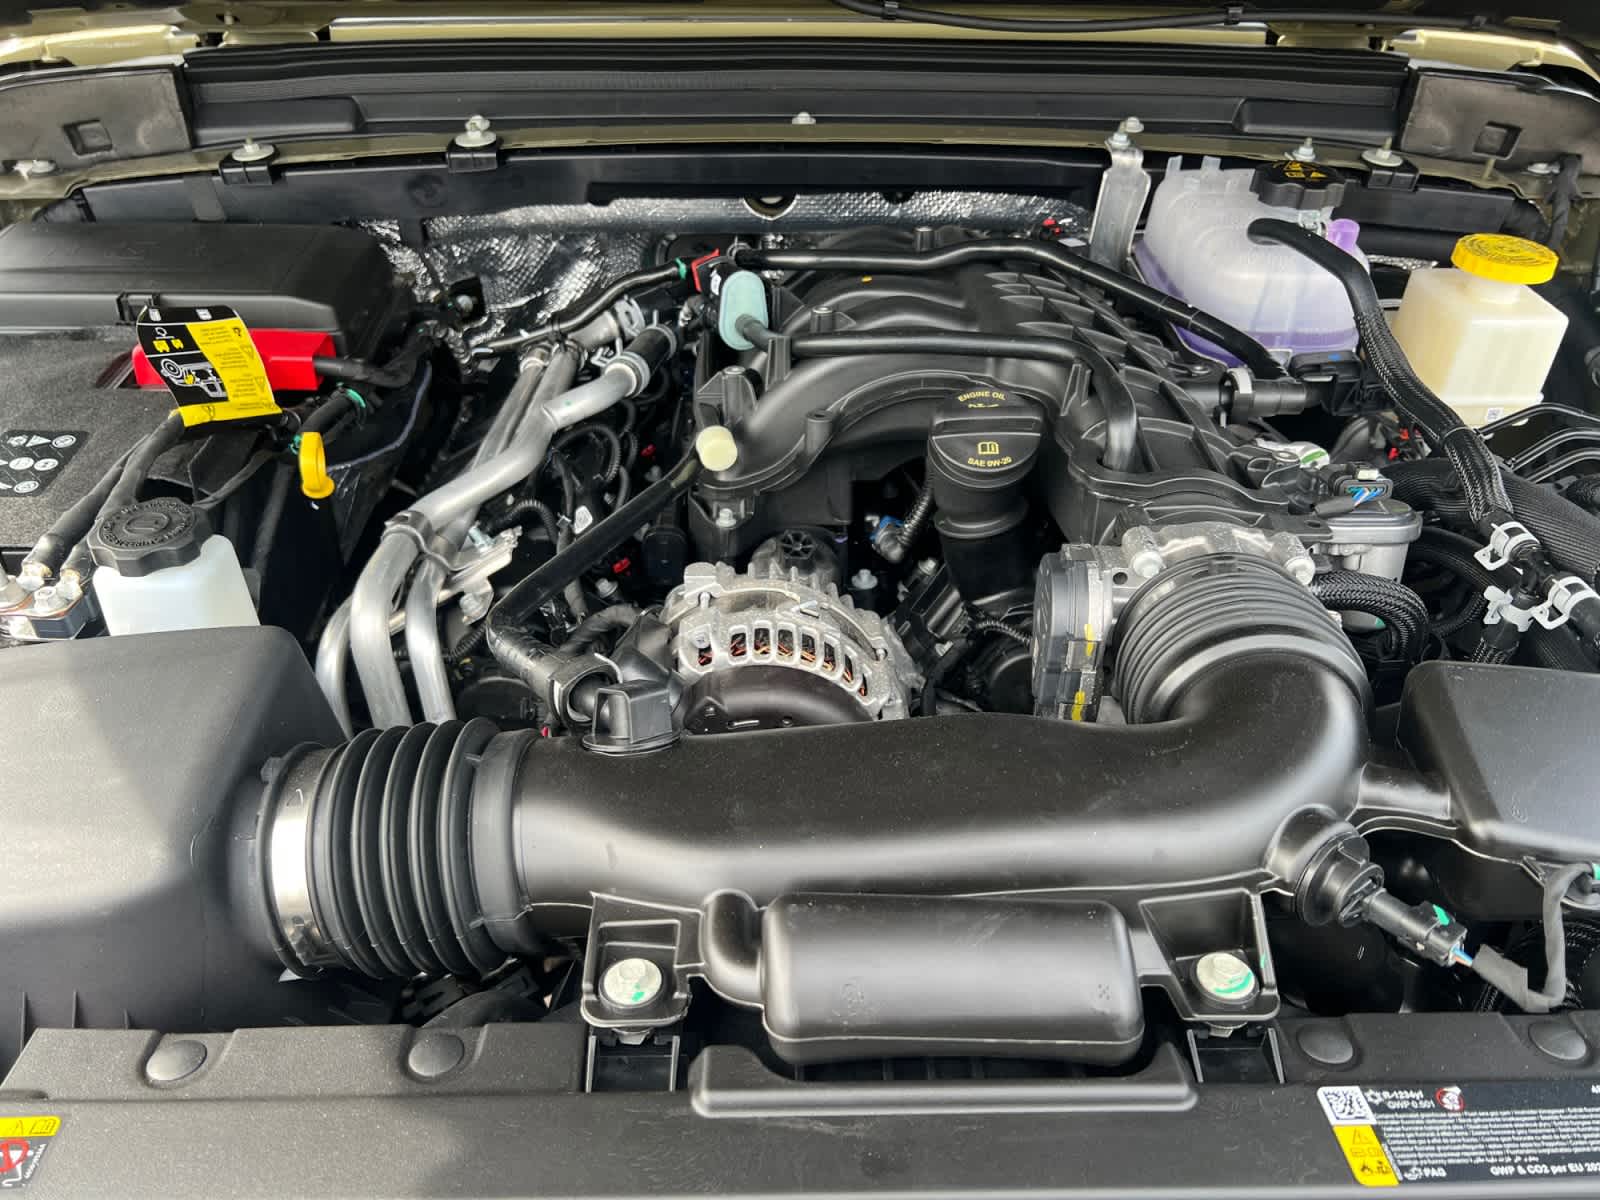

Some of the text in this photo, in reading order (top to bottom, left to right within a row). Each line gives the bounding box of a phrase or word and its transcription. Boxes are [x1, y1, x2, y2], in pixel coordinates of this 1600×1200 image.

[957, 391, 1006, 402] ENGINE OIL
[967, 456, 1012, 467] SAE 0W-20
[1387, 1099, 1410, 1109] GWP
[1490, 1165, 1515, 1176] GWP
[1527, 1163, 1550, 1175] CO2
[1567, 1162, 1584, 1173] EU
